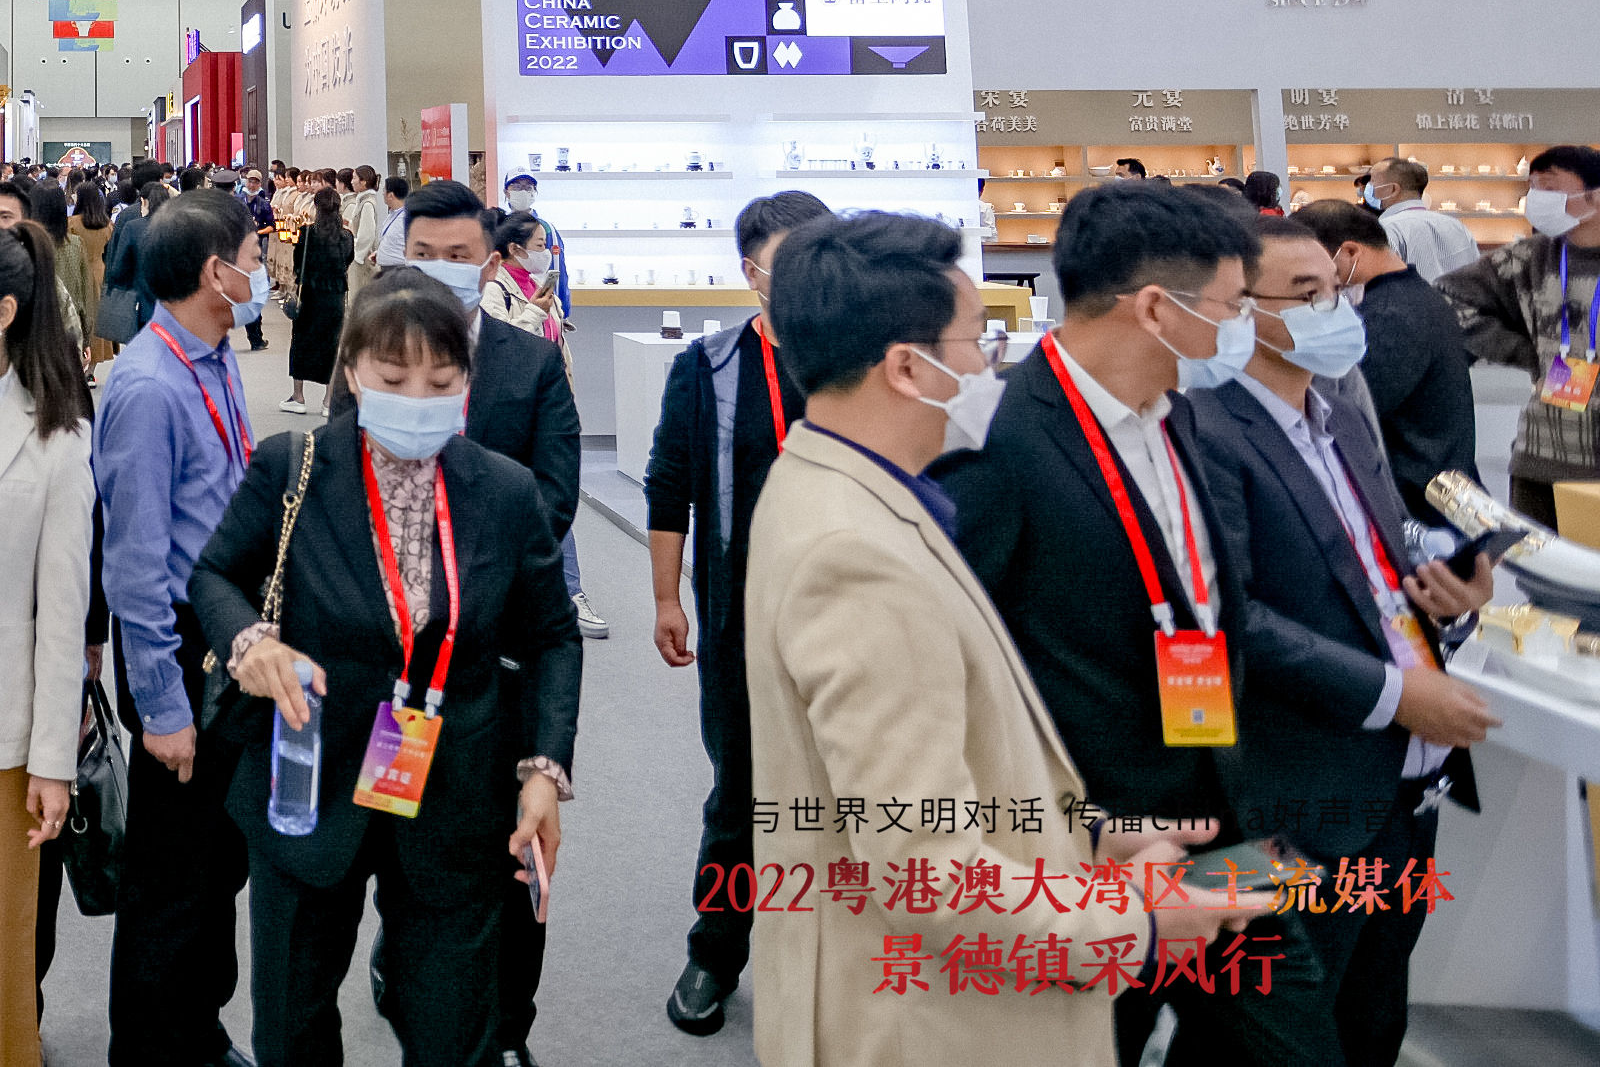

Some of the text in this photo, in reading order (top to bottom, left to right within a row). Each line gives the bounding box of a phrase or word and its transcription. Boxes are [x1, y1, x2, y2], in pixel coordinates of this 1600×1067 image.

[524, 13, 621, 29] CERAMIC
[525, 33, 642, 50] EXHIBITION
[526, 55, 578, 70] 2022
[1128, 115, 1193, 132] 富贵满堂
